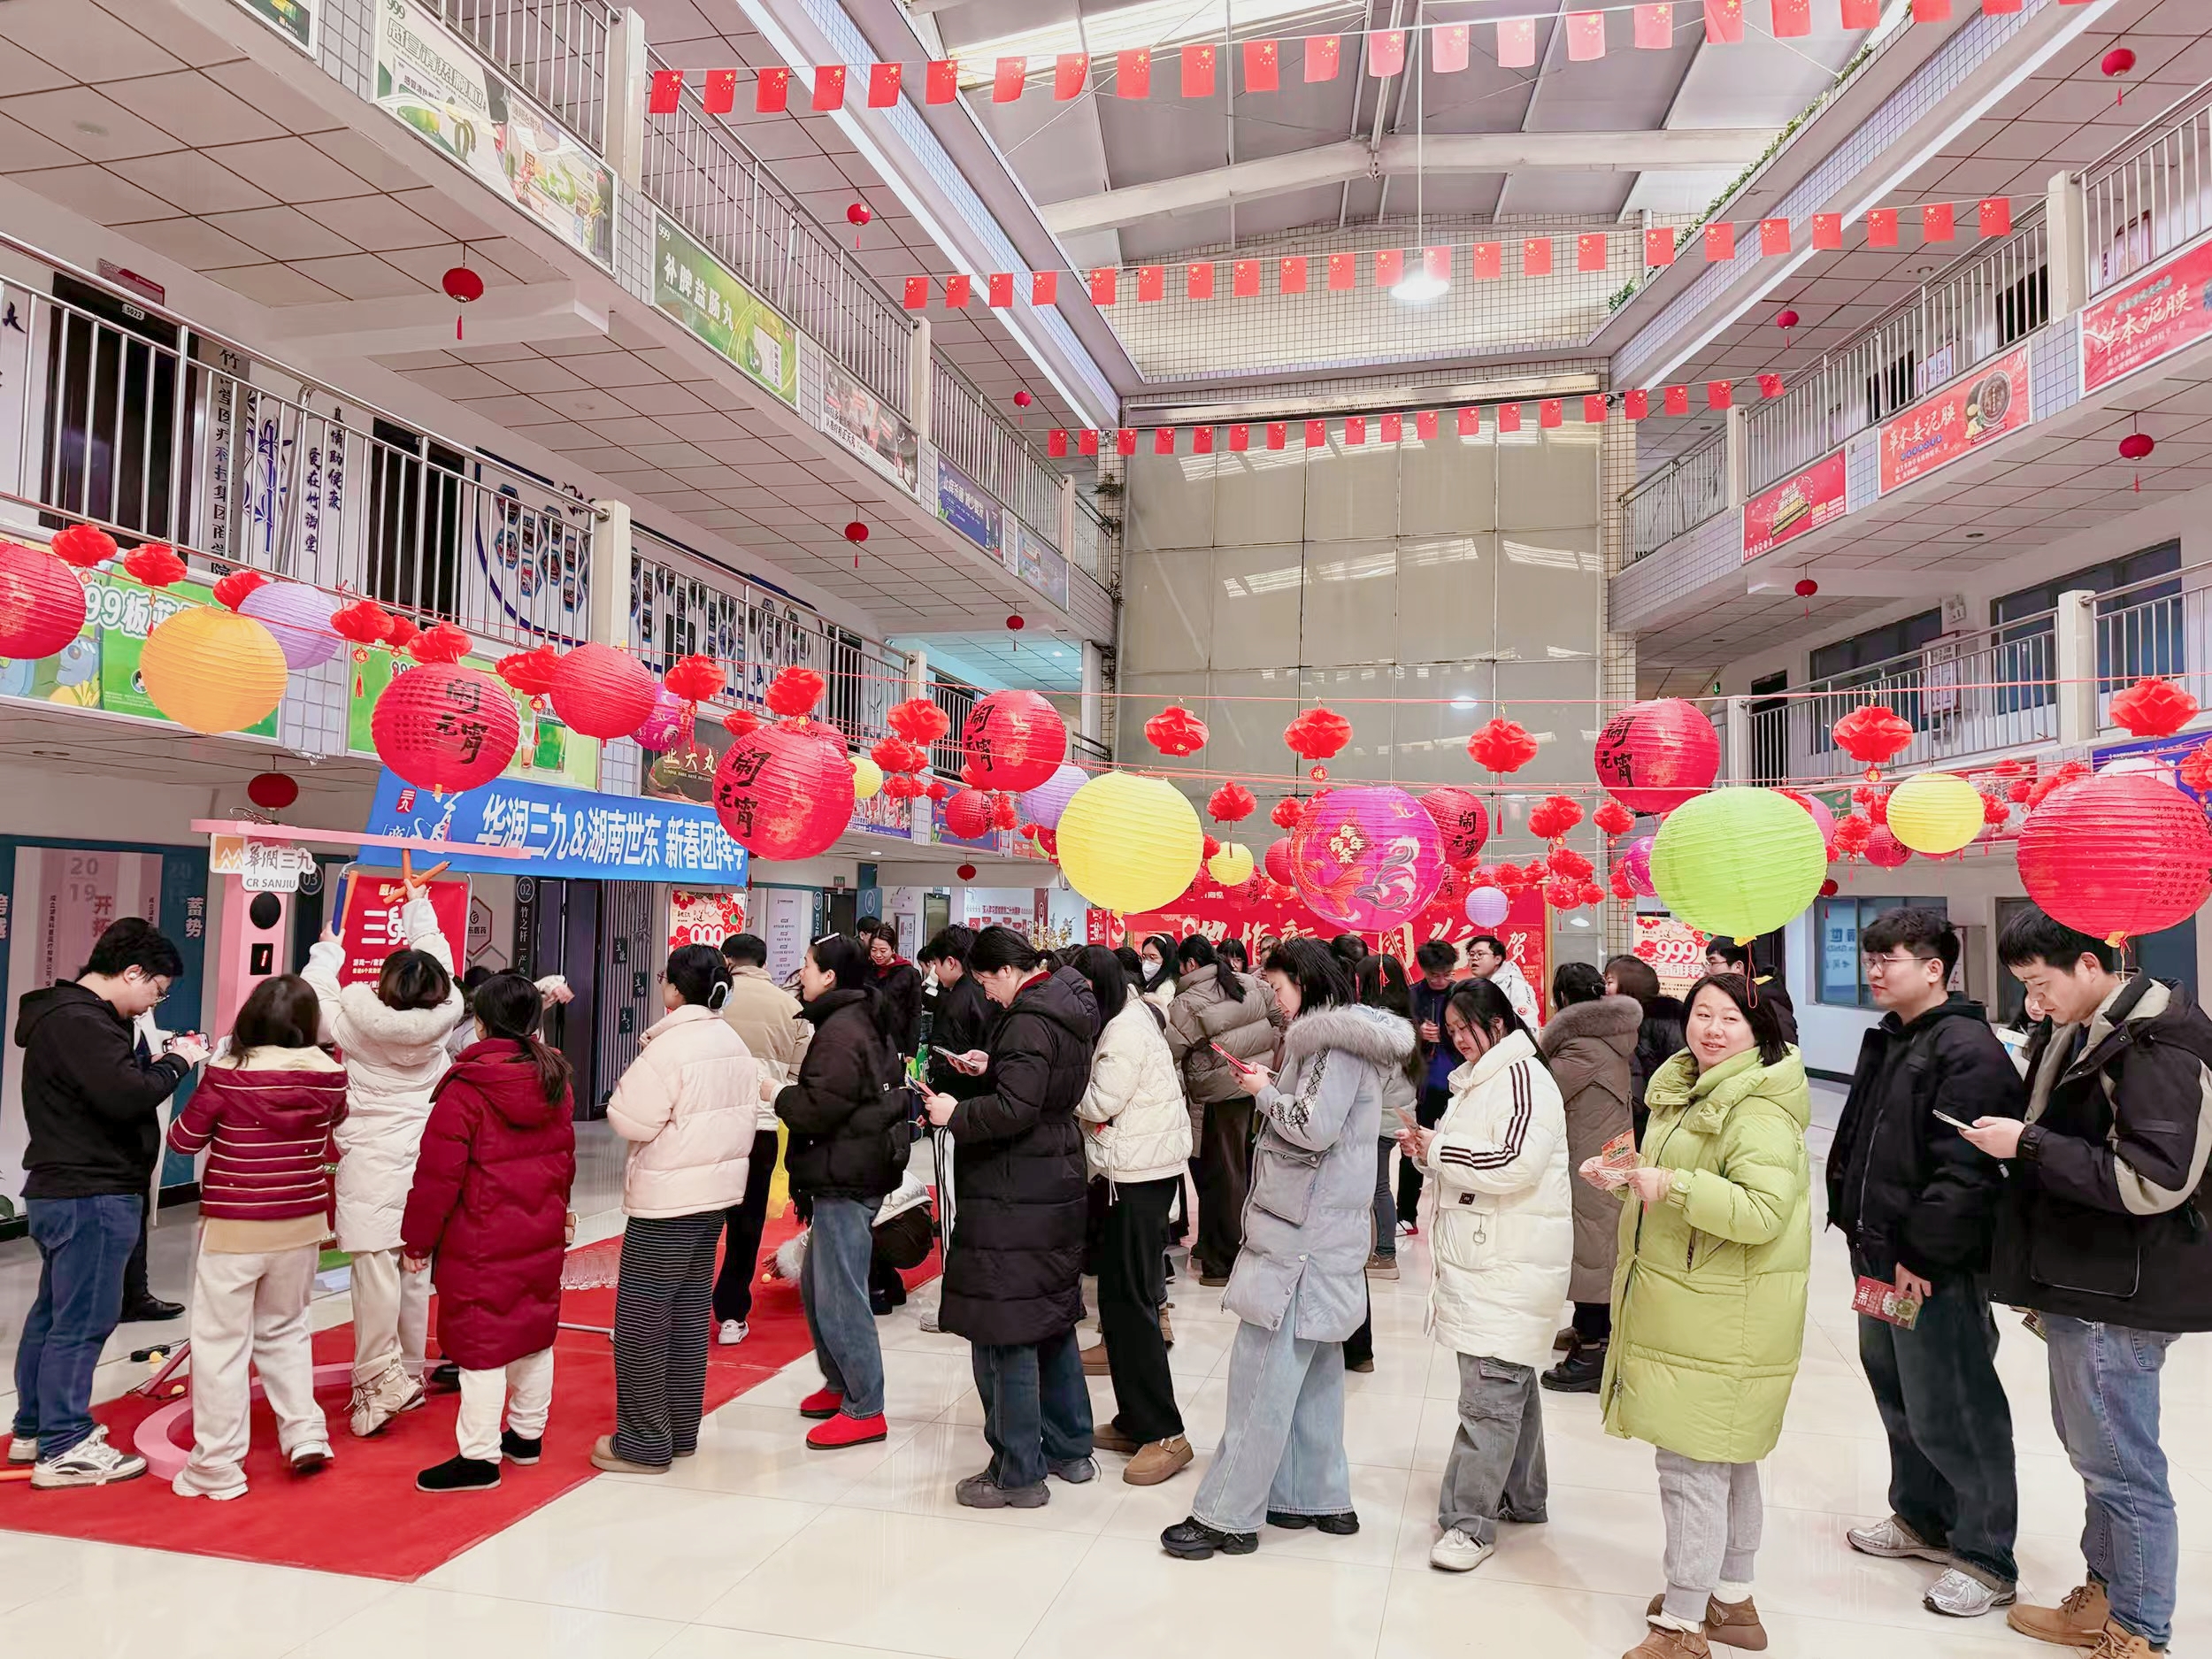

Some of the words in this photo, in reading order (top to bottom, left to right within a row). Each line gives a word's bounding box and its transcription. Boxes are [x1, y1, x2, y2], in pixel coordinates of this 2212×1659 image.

[658, 224, 671, 242] 999
[664, 252, 734, 332] 补脾益肠丸
[125, 307, 143, 319] 5022
[475, 792, 660, 869] 华润三九&湖南世东
[246, 878, 259, 887] CR
[262, 879, 296, 888] SANJIU
[519, 885, 531, 895] 02
[186, 896, 204, 938] 蓄势
[1655, 940, 1699, 964] 999
